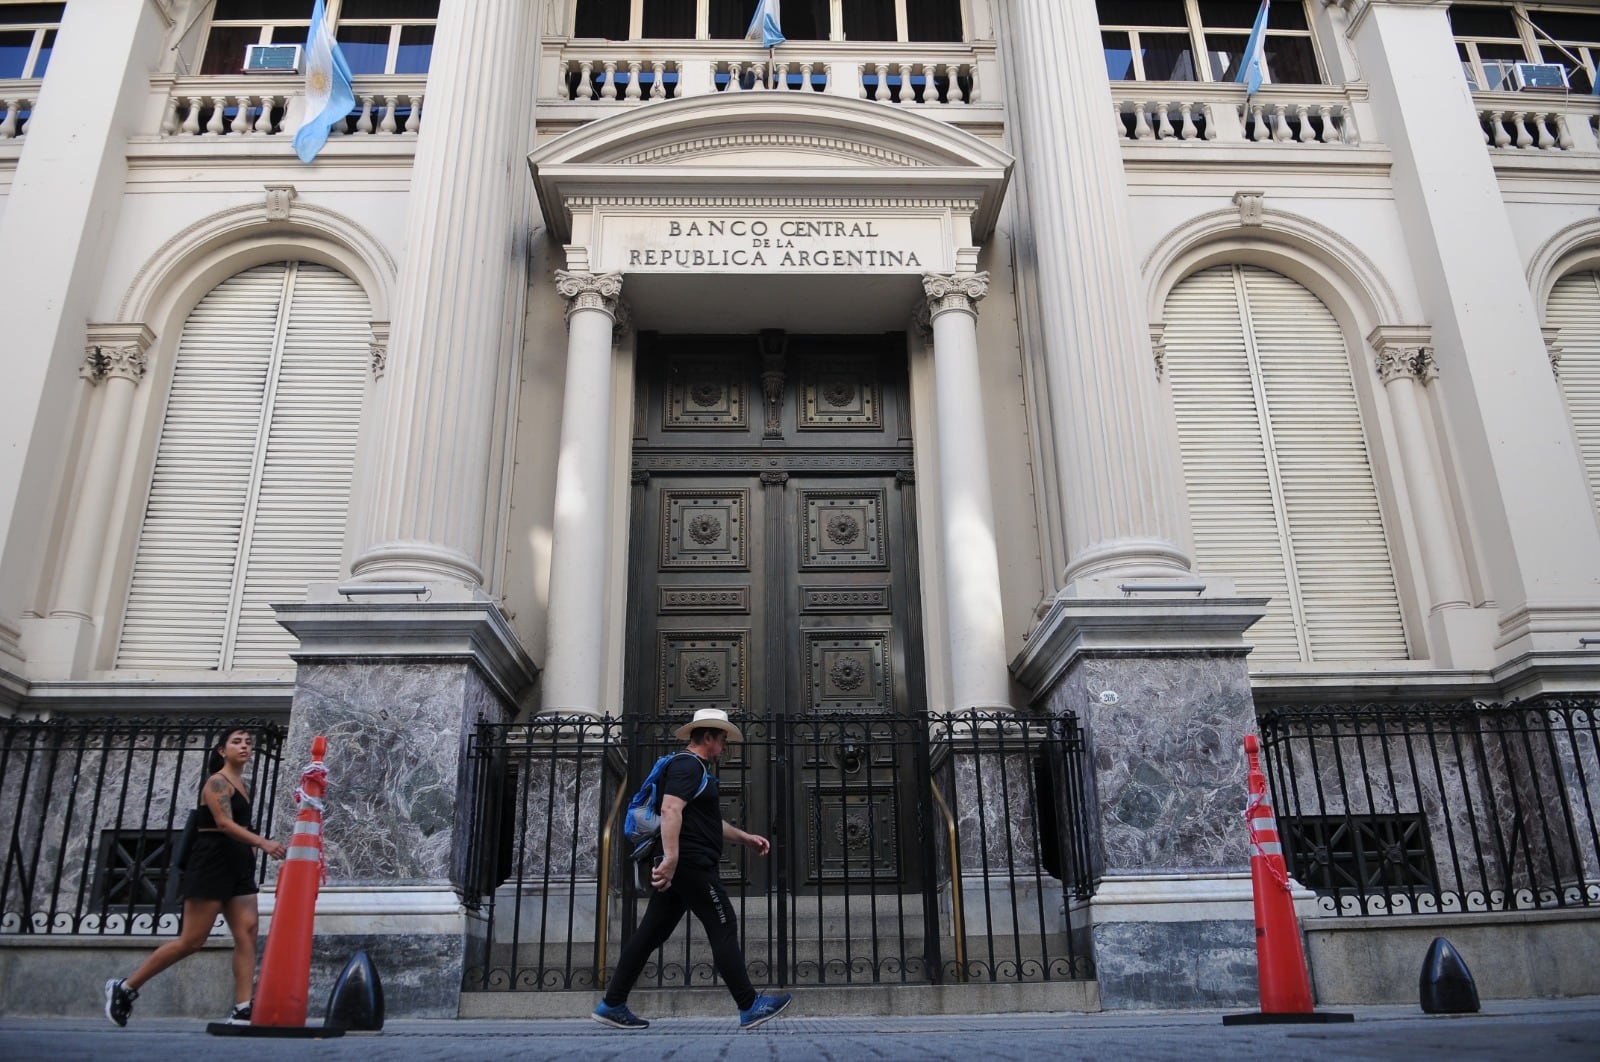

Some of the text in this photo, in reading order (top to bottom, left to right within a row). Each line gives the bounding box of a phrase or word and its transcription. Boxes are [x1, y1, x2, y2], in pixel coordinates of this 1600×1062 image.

[669, 220, 879, 238] BANCO CENTRAL
[752, 238, 795, 248] DE LA
[629, 249, 922, 267] REPUBLICA ARGENTINA
